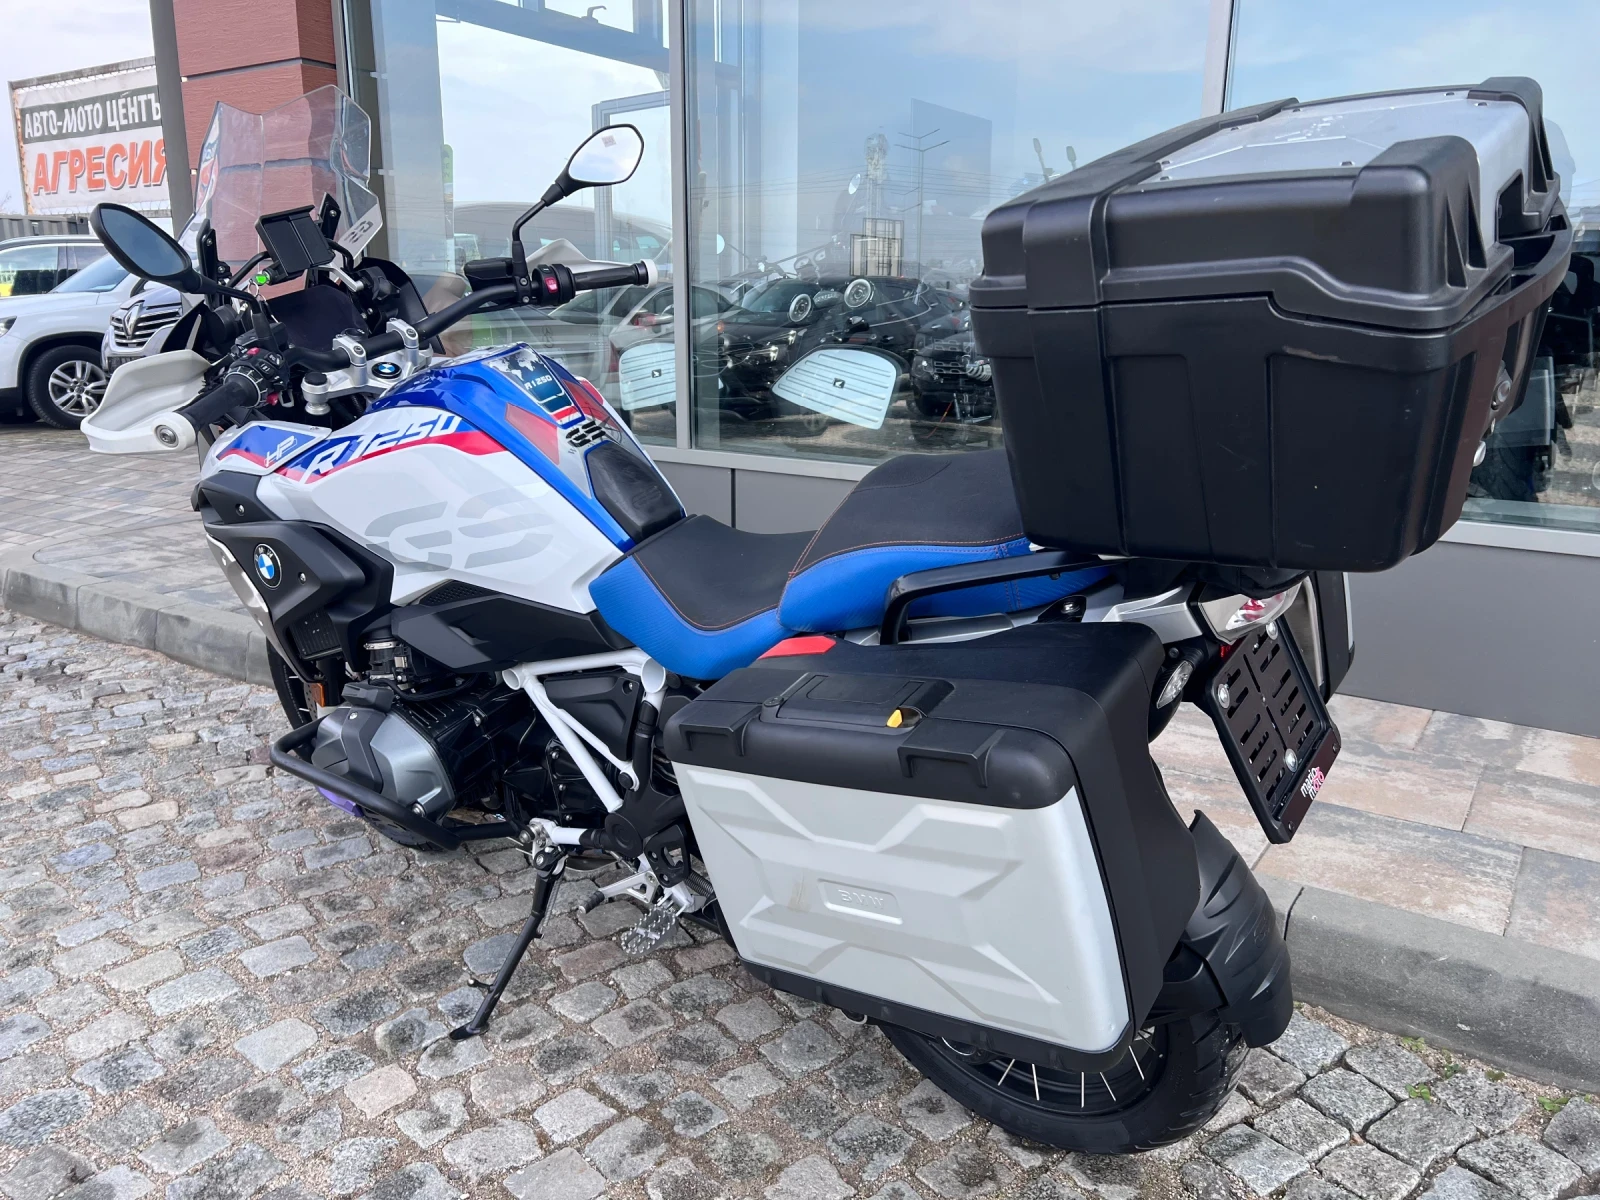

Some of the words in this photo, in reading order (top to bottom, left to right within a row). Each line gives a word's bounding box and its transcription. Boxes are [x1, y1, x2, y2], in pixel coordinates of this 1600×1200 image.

[24, 102, 103, 139] АВТО-МОТО
[106, 93, 161, 131] ЦЕНТЪ
[33, 138, 167, 195] АГРЕСИЯ
[566, 420, 606, 447] GS
[364, 483, 555, 576] GS
